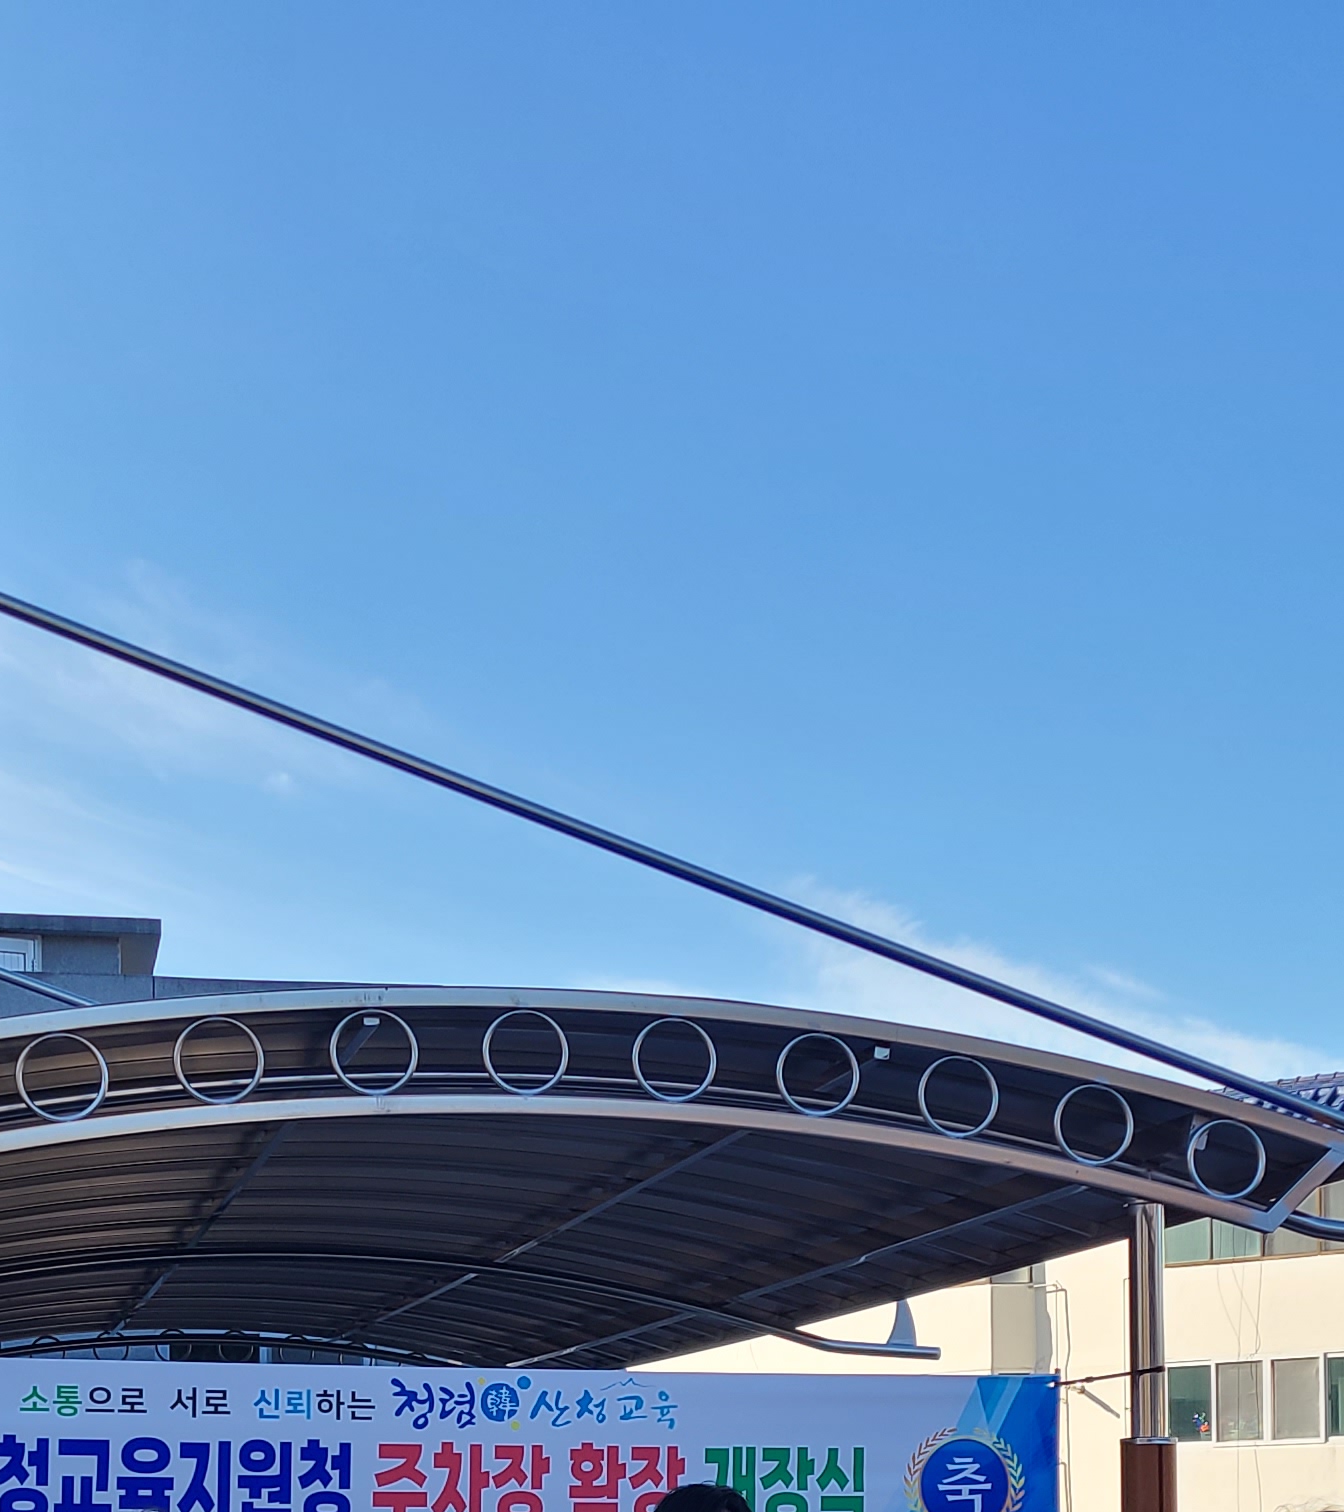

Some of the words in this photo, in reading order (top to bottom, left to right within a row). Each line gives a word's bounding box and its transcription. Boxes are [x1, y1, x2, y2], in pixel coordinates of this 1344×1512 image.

[19, 1385, 148, 1417] 소통으로
[169, 1387, 231, 1418] 서로
[253, 1388, 376, 1420] 신뢰하는
